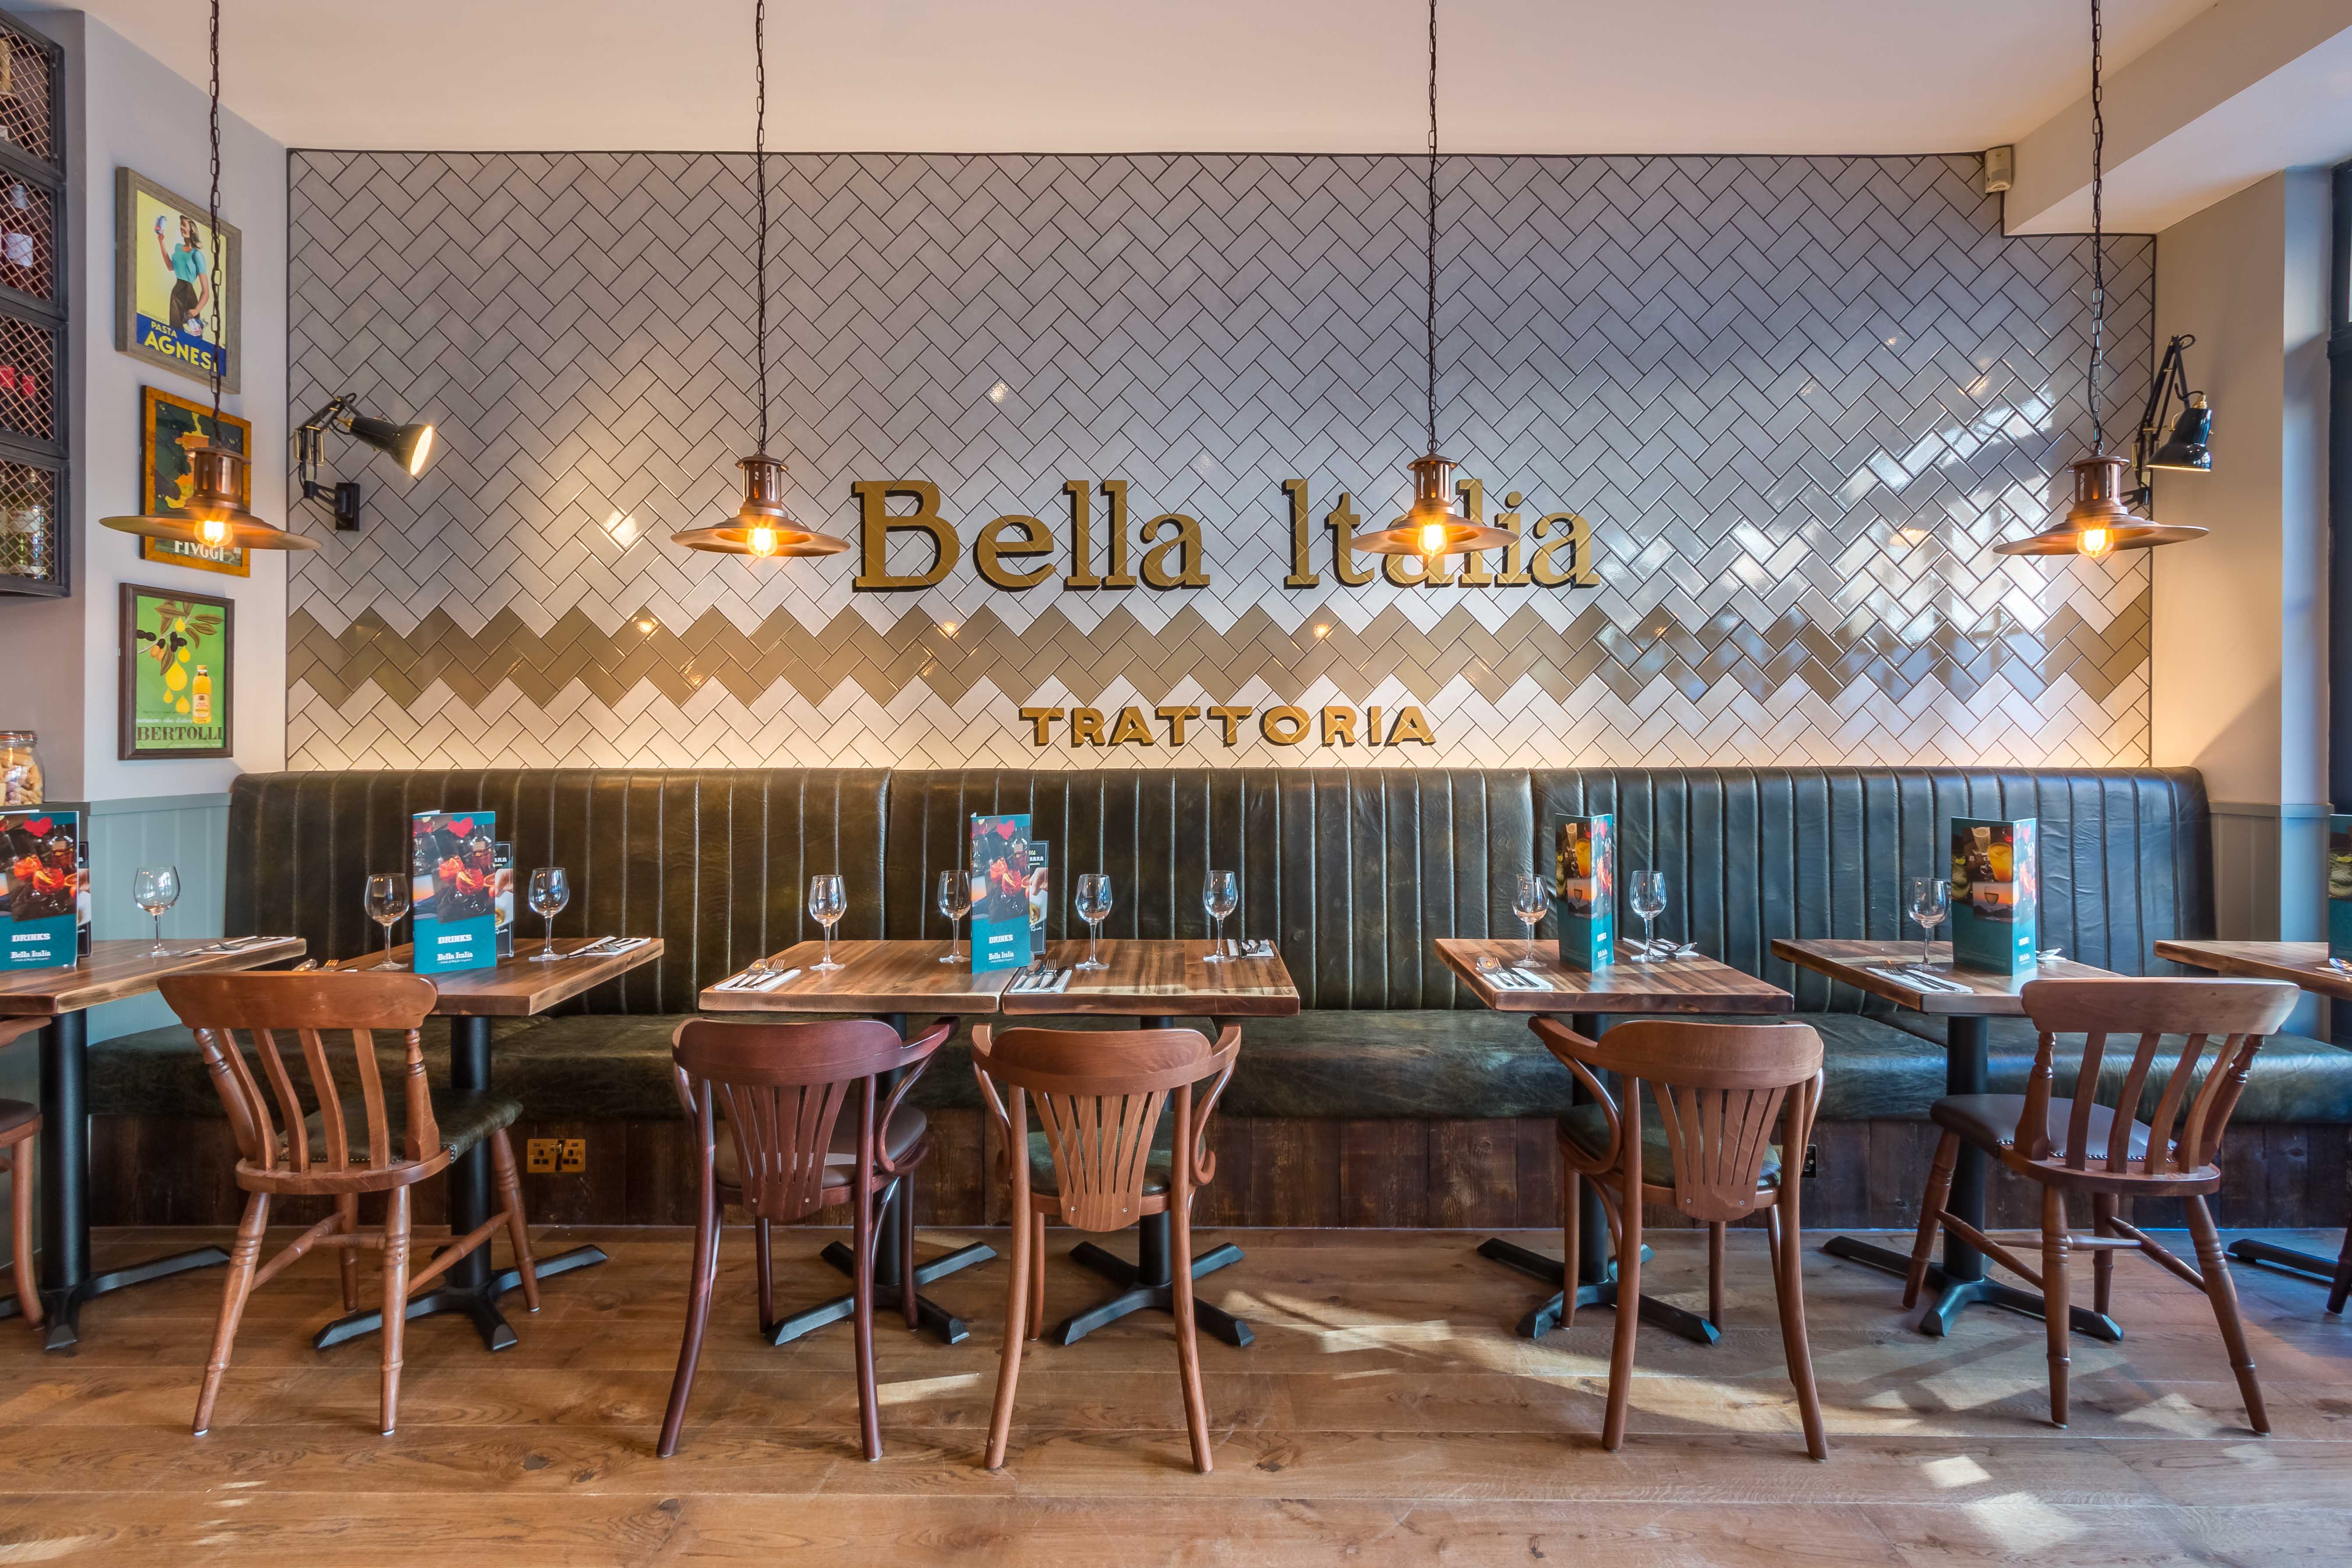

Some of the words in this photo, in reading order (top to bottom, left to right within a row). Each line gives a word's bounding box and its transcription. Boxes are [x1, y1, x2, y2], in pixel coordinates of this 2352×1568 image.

[151, 321, 177, 338] PASTA
[851, 480, 1211, 593] Bella
[137, 726, 222, 741] BERTOLLI
[1018, 706, 1437, 747] TRATTORIA
[12, 933, 50, 942] DRINKS
[438, 935, 472, 944] DRINKS
[989, 935, 1013, 944] DRINKS
